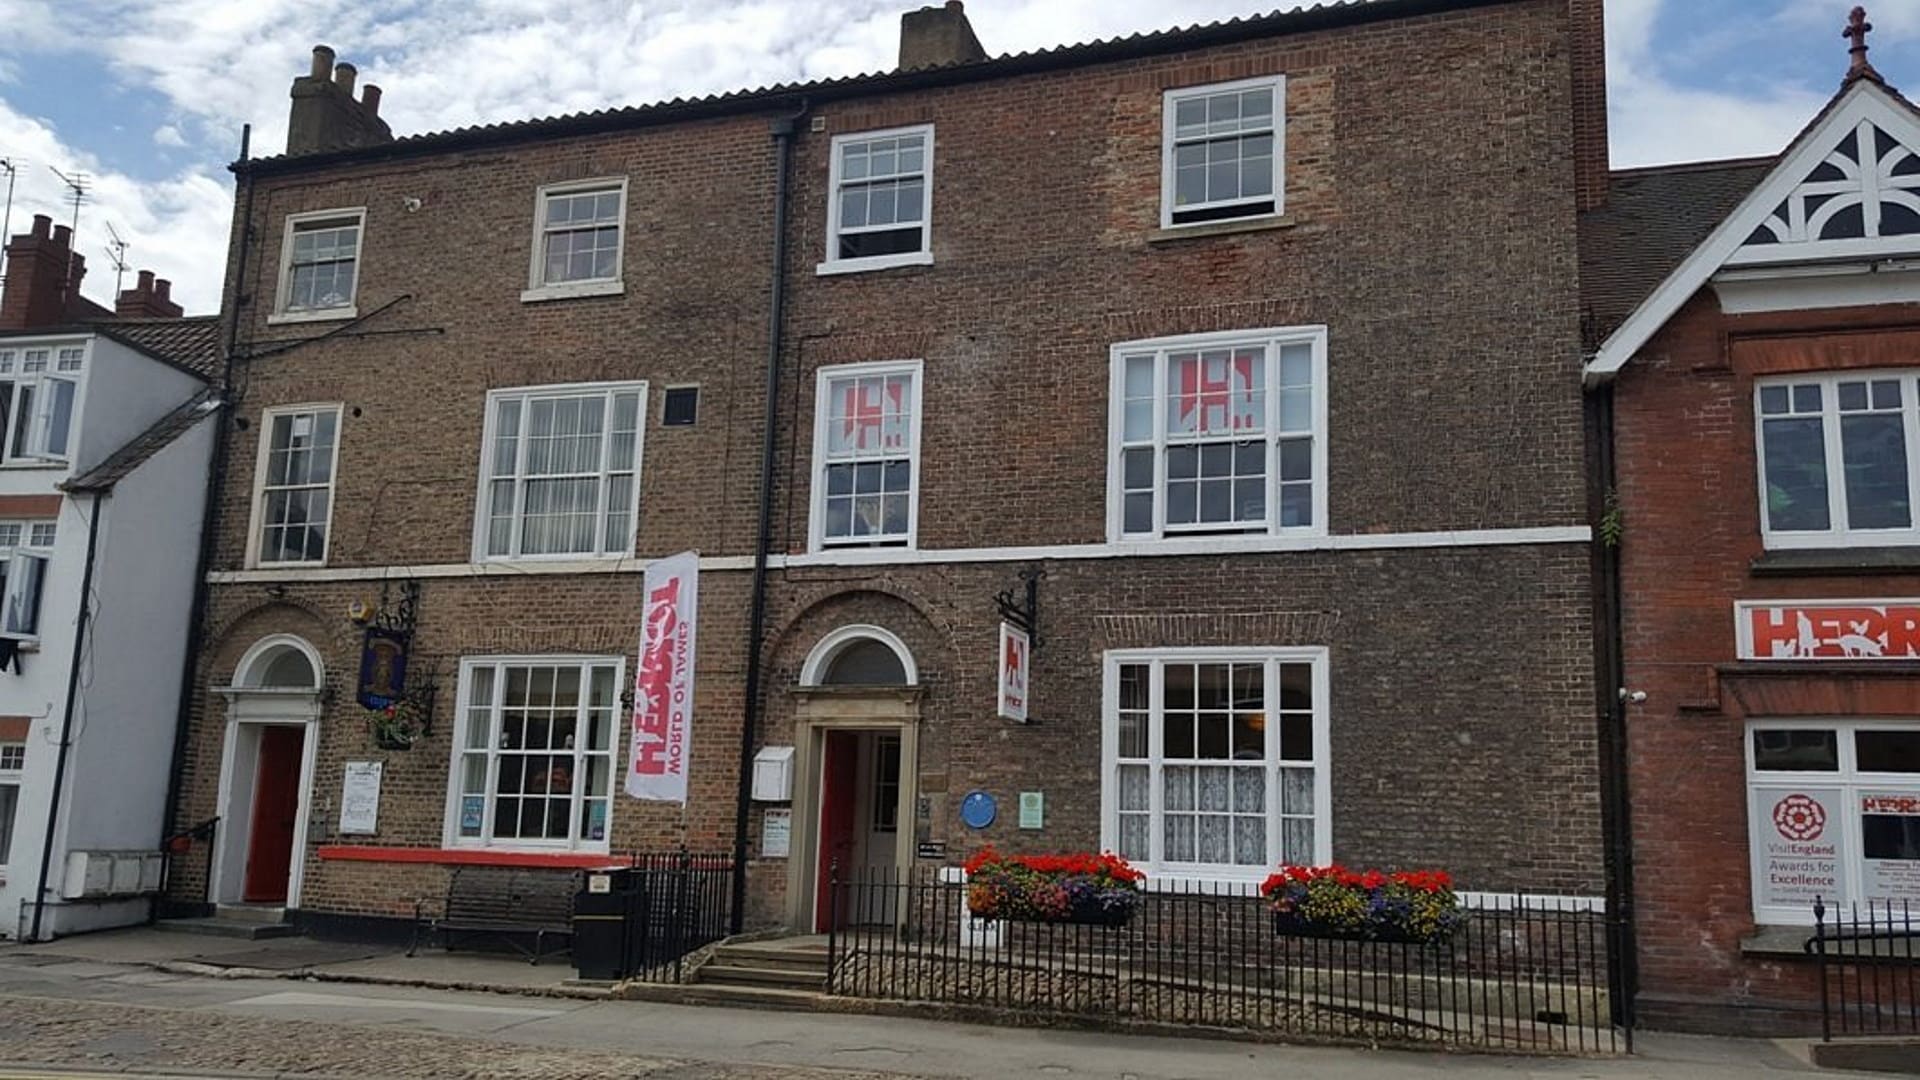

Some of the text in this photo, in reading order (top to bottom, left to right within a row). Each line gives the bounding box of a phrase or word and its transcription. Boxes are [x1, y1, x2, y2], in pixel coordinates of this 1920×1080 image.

[1769, 860, 1835, 873] Awards for
[1770, 873, 1835, 886] Excellence
